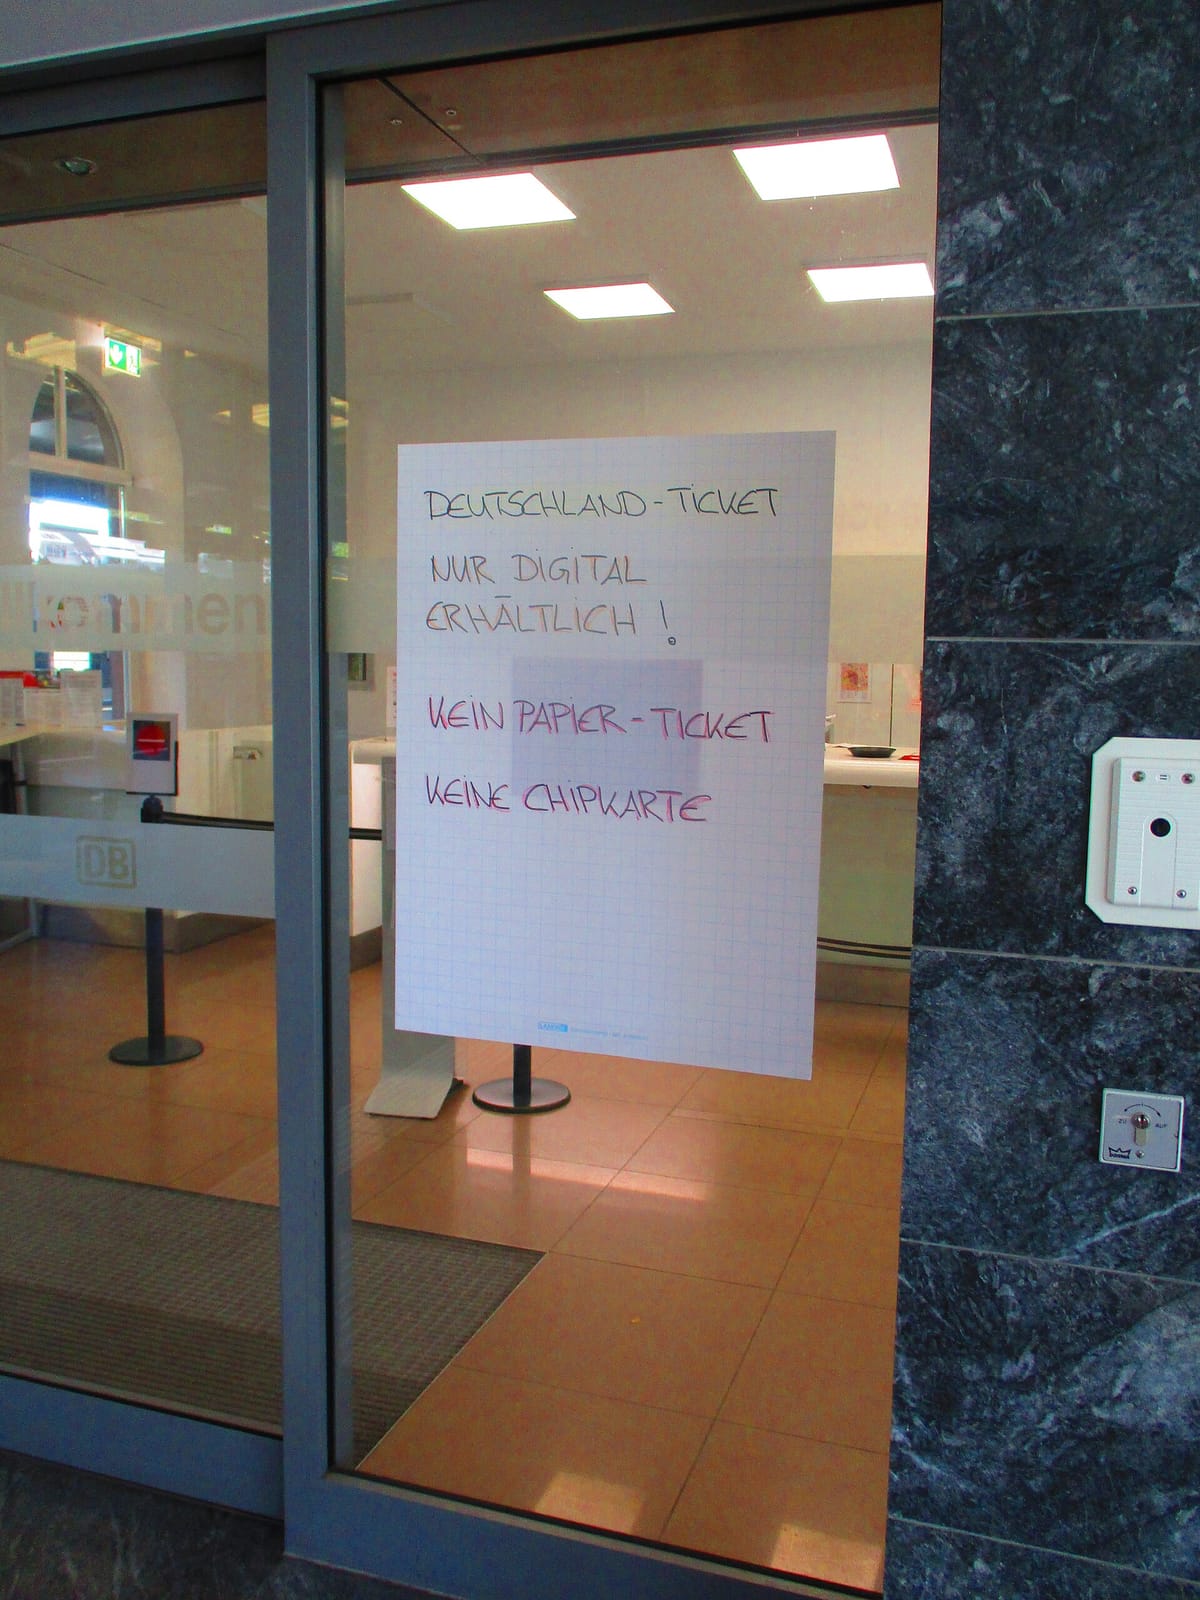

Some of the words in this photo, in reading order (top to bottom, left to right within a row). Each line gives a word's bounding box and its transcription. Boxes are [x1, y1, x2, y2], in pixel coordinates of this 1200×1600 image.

[430, 555, 496, 584] NUR
[511, 547, 648, 586] DIGITAL
[428, 695, 504, 731] KEIN
[426, 774, 512, 811] KEINE
[523, 779, 713, 823] CHIPKARTE
[82, 841, 131, 882] DB
